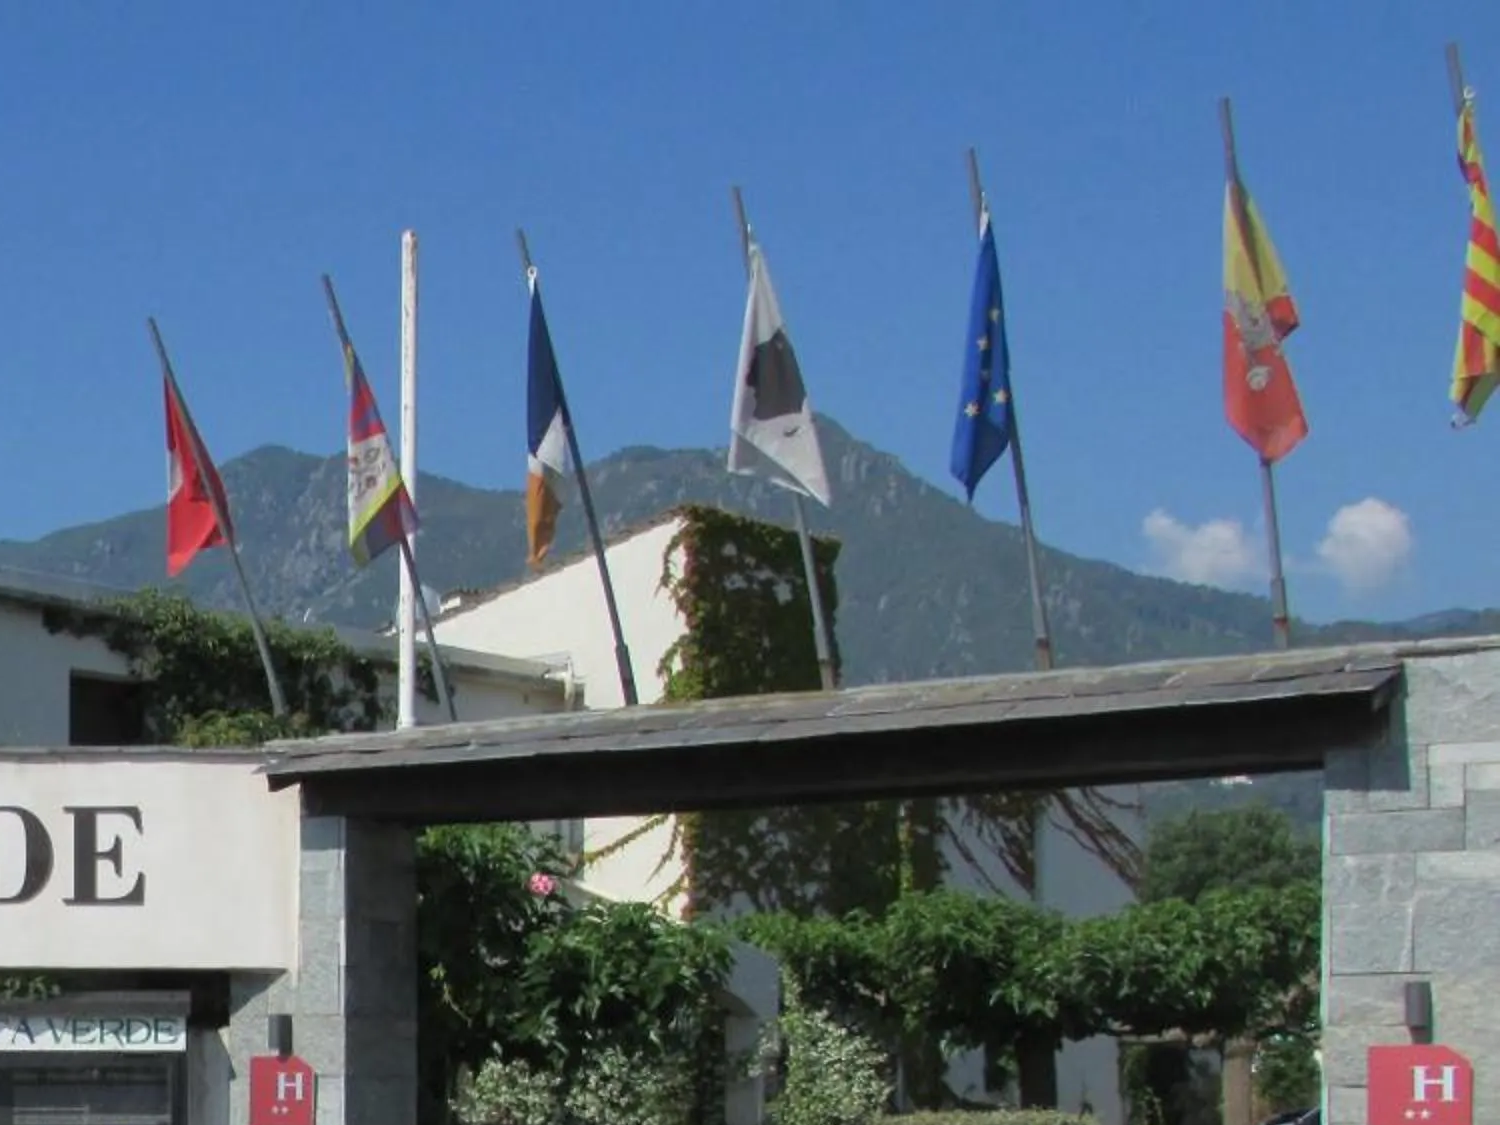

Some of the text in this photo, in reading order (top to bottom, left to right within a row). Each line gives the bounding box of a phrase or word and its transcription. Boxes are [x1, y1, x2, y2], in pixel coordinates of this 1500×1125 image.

[44, 1016, 180, 1045] VERDE
[277, 1072, 304, 1102] H
[1411, 1065, 1459, 1102] H
